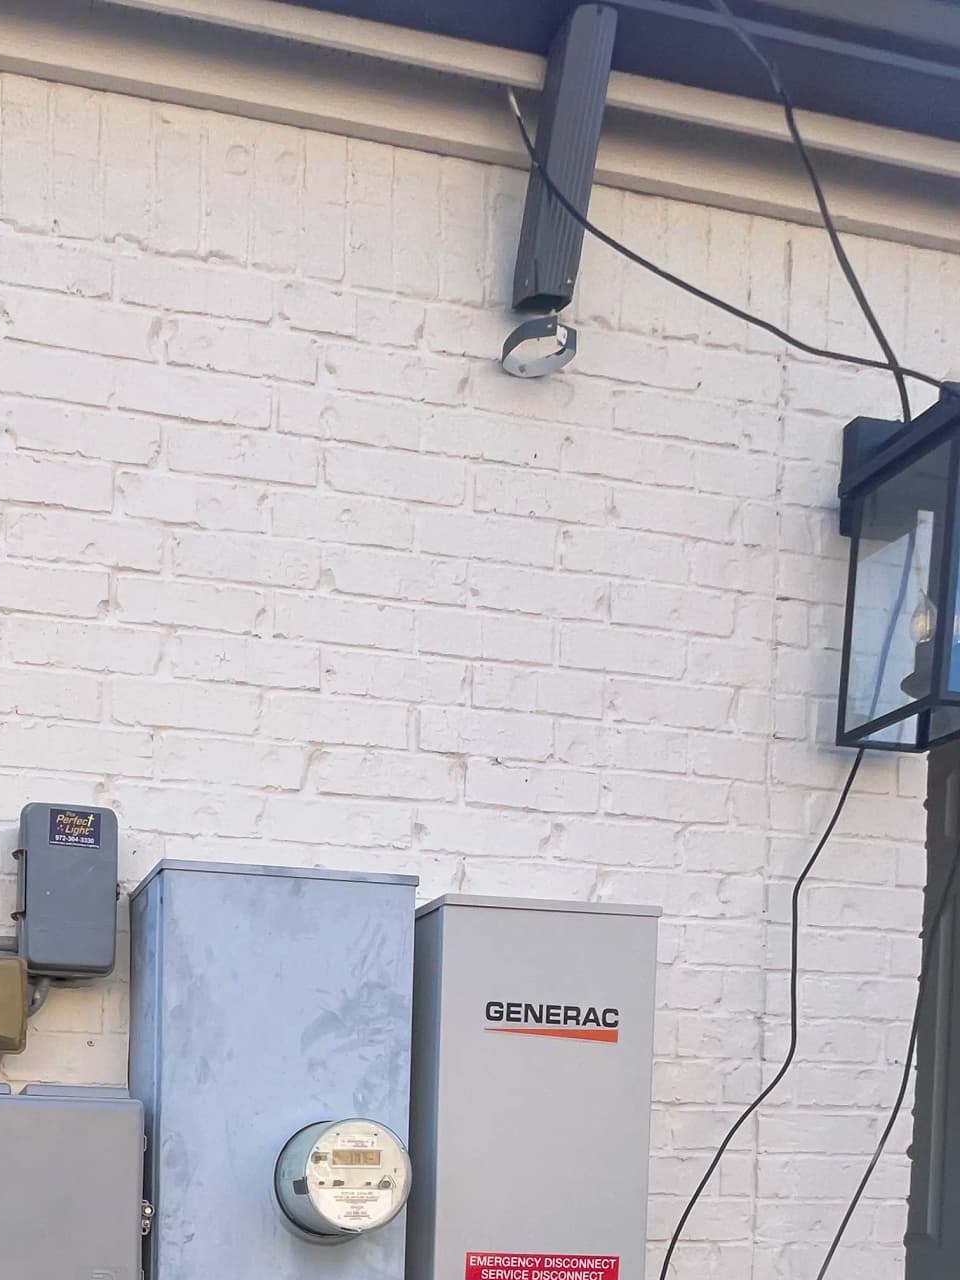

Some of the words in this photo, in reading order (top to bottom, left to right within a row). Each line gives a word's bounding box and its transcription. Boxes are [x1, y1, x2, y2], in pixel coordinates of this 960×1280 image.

[56, 814, 95, 827] Perfect
[65, 825, 90, 836] Light
[485, 1001, 619, 1028] GENERAC
[469, 1255, 541, 1268] EMERGENCY
[544, 1257, 617, 1270] DISCONNECT
[481, 1269, 529, 1280] SERVICE
